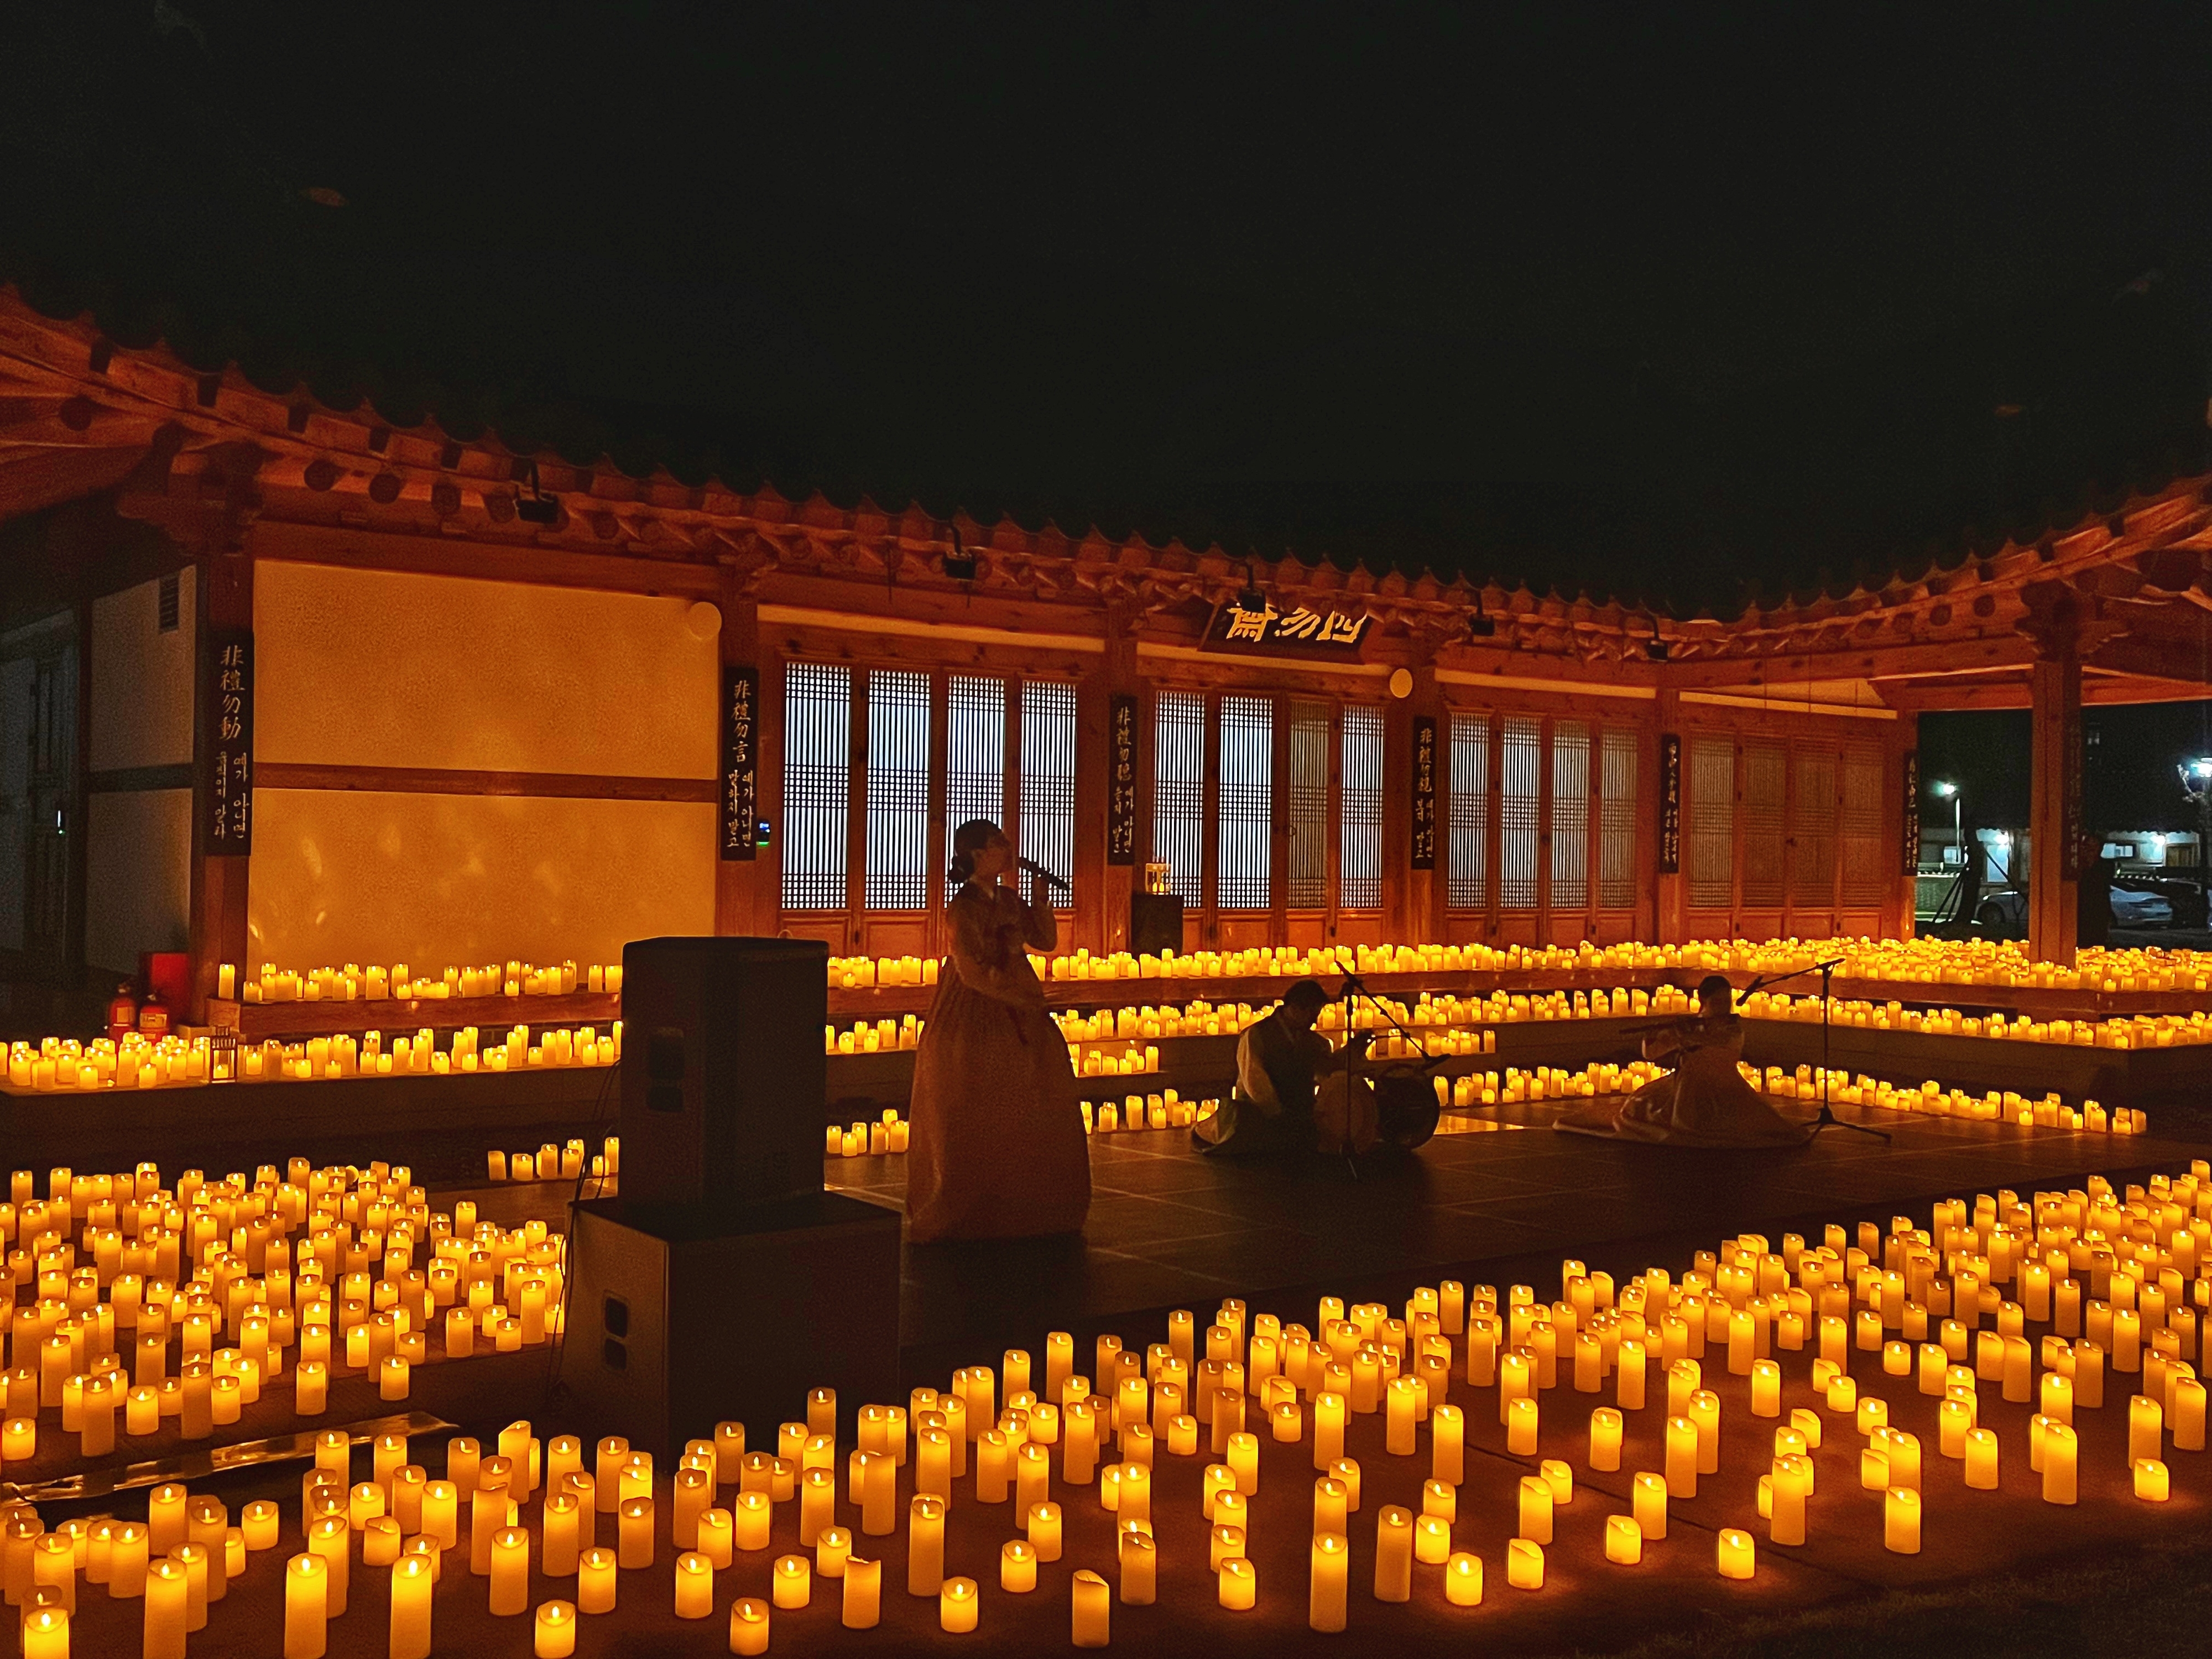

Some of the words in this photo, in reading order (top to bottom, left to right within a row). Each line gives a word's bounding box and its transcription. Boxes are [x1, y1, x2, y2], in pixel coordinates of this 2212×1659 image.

[219, 644, 246, 741] 非禮勿動
[731, 680, 752, 763] 非禮勿言
[215, 751, 227, 799] 움직이지
[233, 752, 248, 782] 예가
[742, 769, 755, 801] 예가
[727, 769, 740, 815] 말하지
[1125, 785, 1134, 811] 예가
[233, 792, 250, 839] 아니면
[727, 818, 739, 848] 말고
[741, 805, 754, 847] 아니면
[1124, 816, 1134, 853] 아니면
